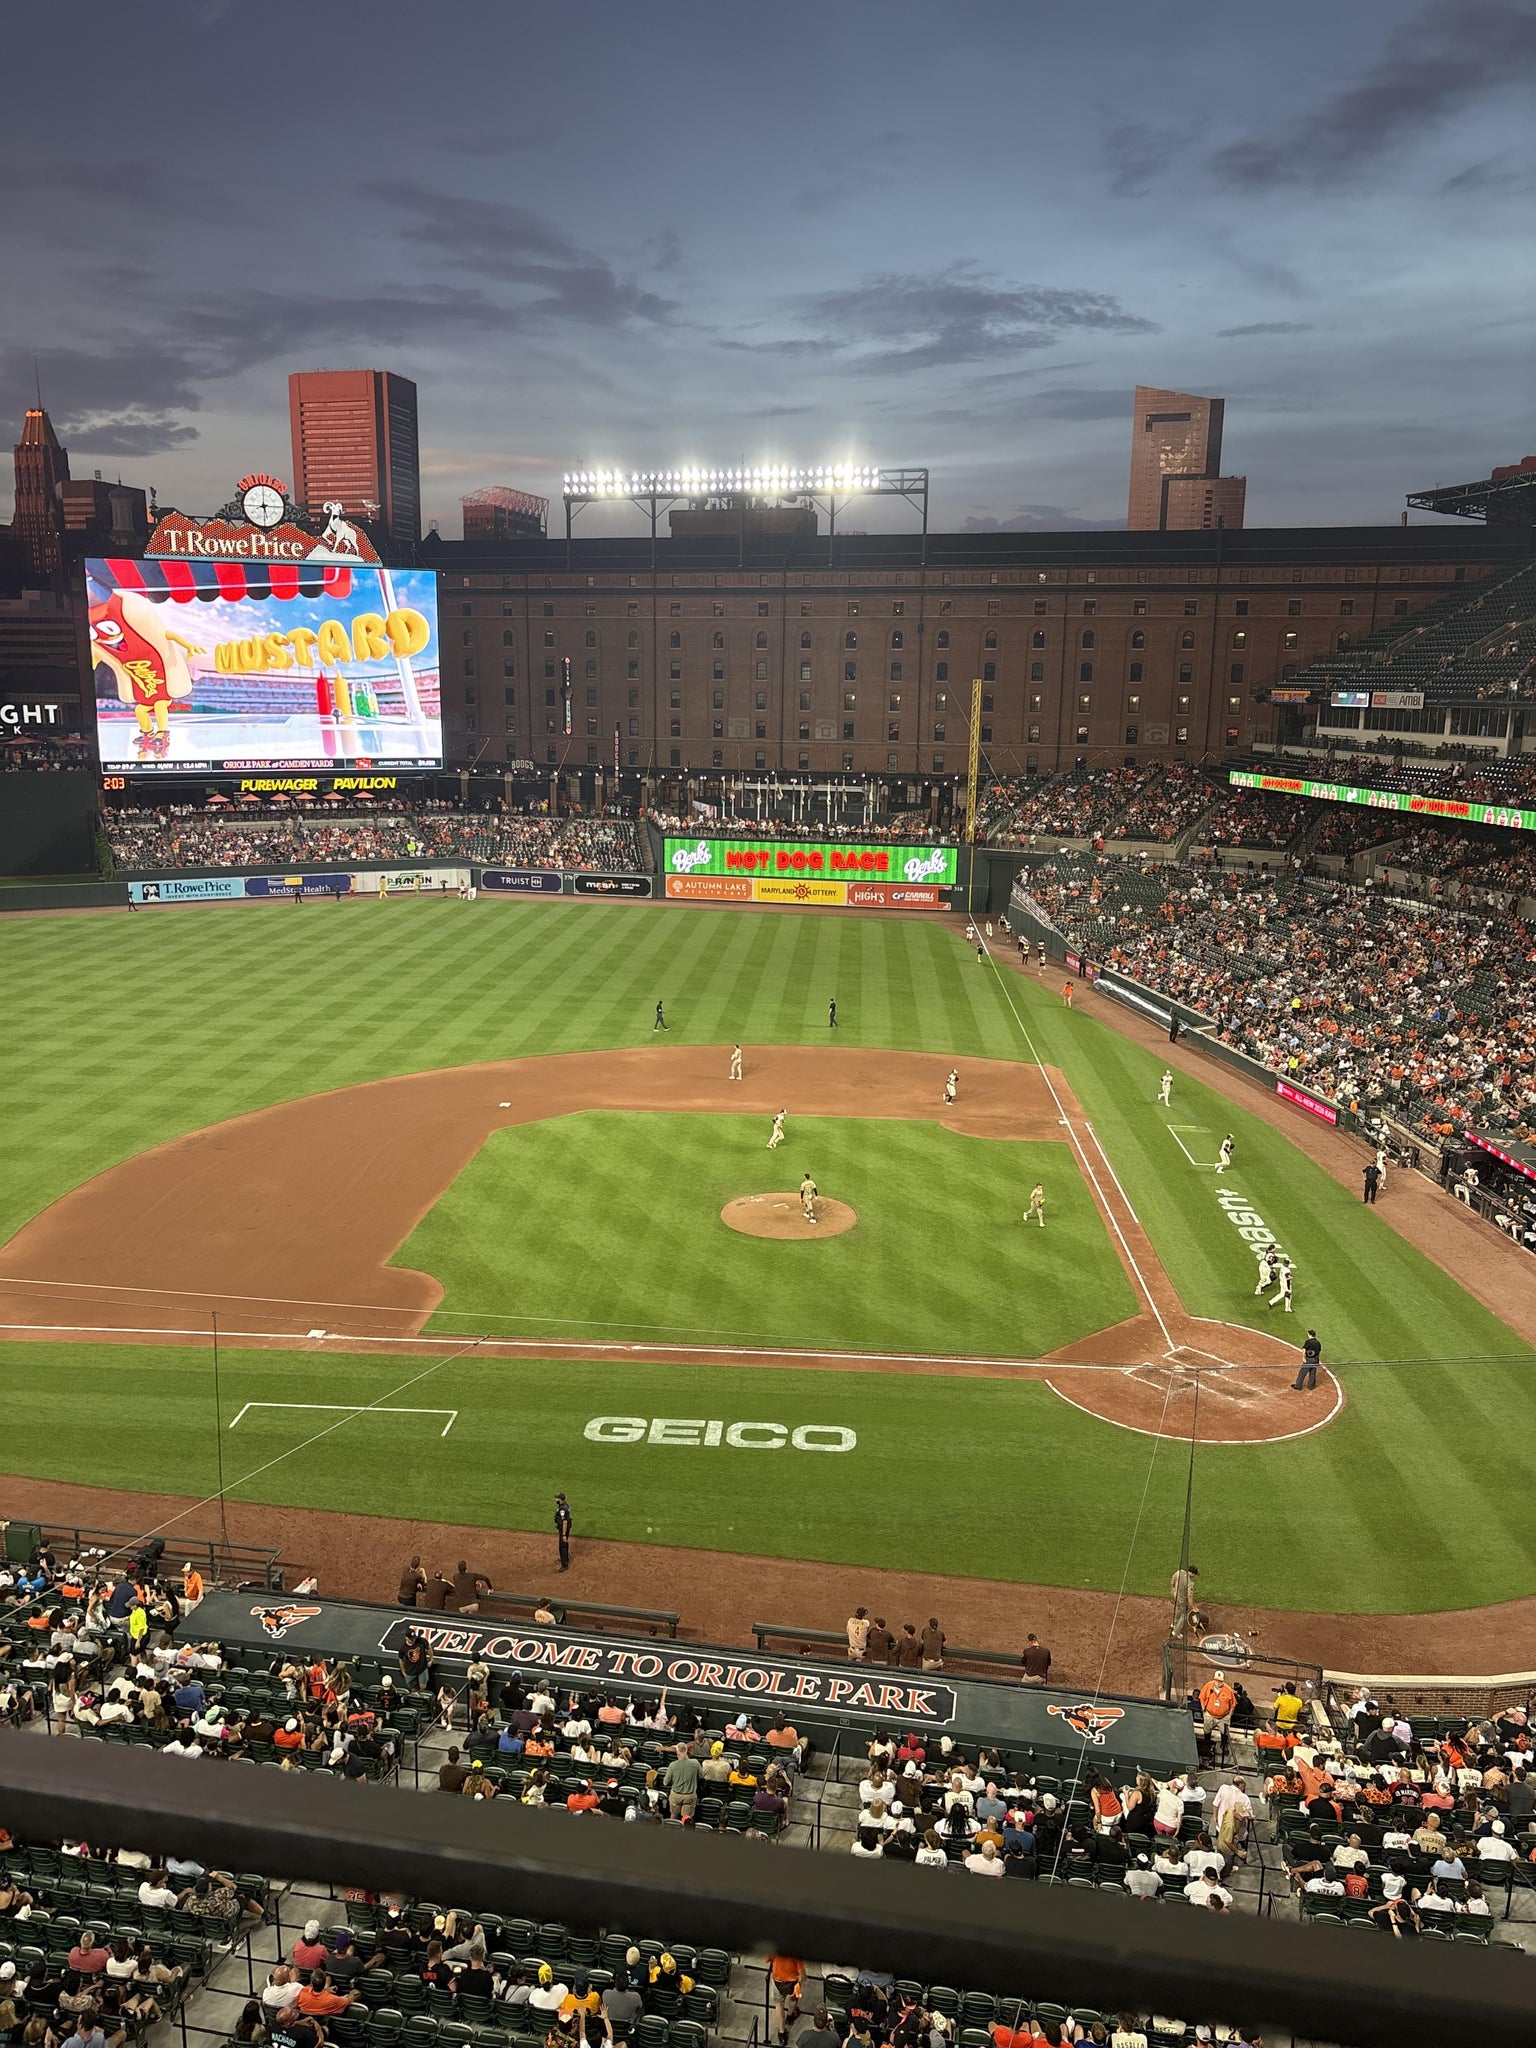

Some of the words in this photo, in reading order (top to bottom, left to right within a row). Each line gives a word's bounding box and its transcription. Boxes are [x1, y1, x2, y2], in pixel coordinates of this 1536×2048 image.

[239, 473, 287, 494] ORIOLES
[214, 607, 430, 674] MUSTARD
[0, 704, 58, 724] GHT
[223, 761, 251, 769] ORIOLE
[252, 761, 272, 769] PARK
[279, 760, 310, 768] CAMDEN
[311, 760, 334, 768] YARDS
[103, 777, 125, 790] 2:03
[241, 778, 318, 792] PUREWAGER
[334, 778, 397, 790] PAVILION
[1427, 801, 1445, 813] DOG
[726, 850, 771, 870] HOT
[776, 850, 824, 870] DOG
[830, 851, 890, 872] RACE
[500, 876, 530, 886] TRUIST
[685, 881, 723, 890] AUTUMN
[724, 883, 747, 891] LAKE
[304, 884, 331, 893] Health
[761, 887, 795, 895] MARYLAND
[854, 891, 885, 904] HIGH'S
[583, 1416, 857, 1452] GEICO
[606, 1650, 663, 1678] TO
[666, 1660, 821, 1700] ORIOLE
[825, 1678, 937, 1716] PARK
[271, 2032, 297, 2048] MACHADO
[1227, 2026, 1237, 2041] 2
